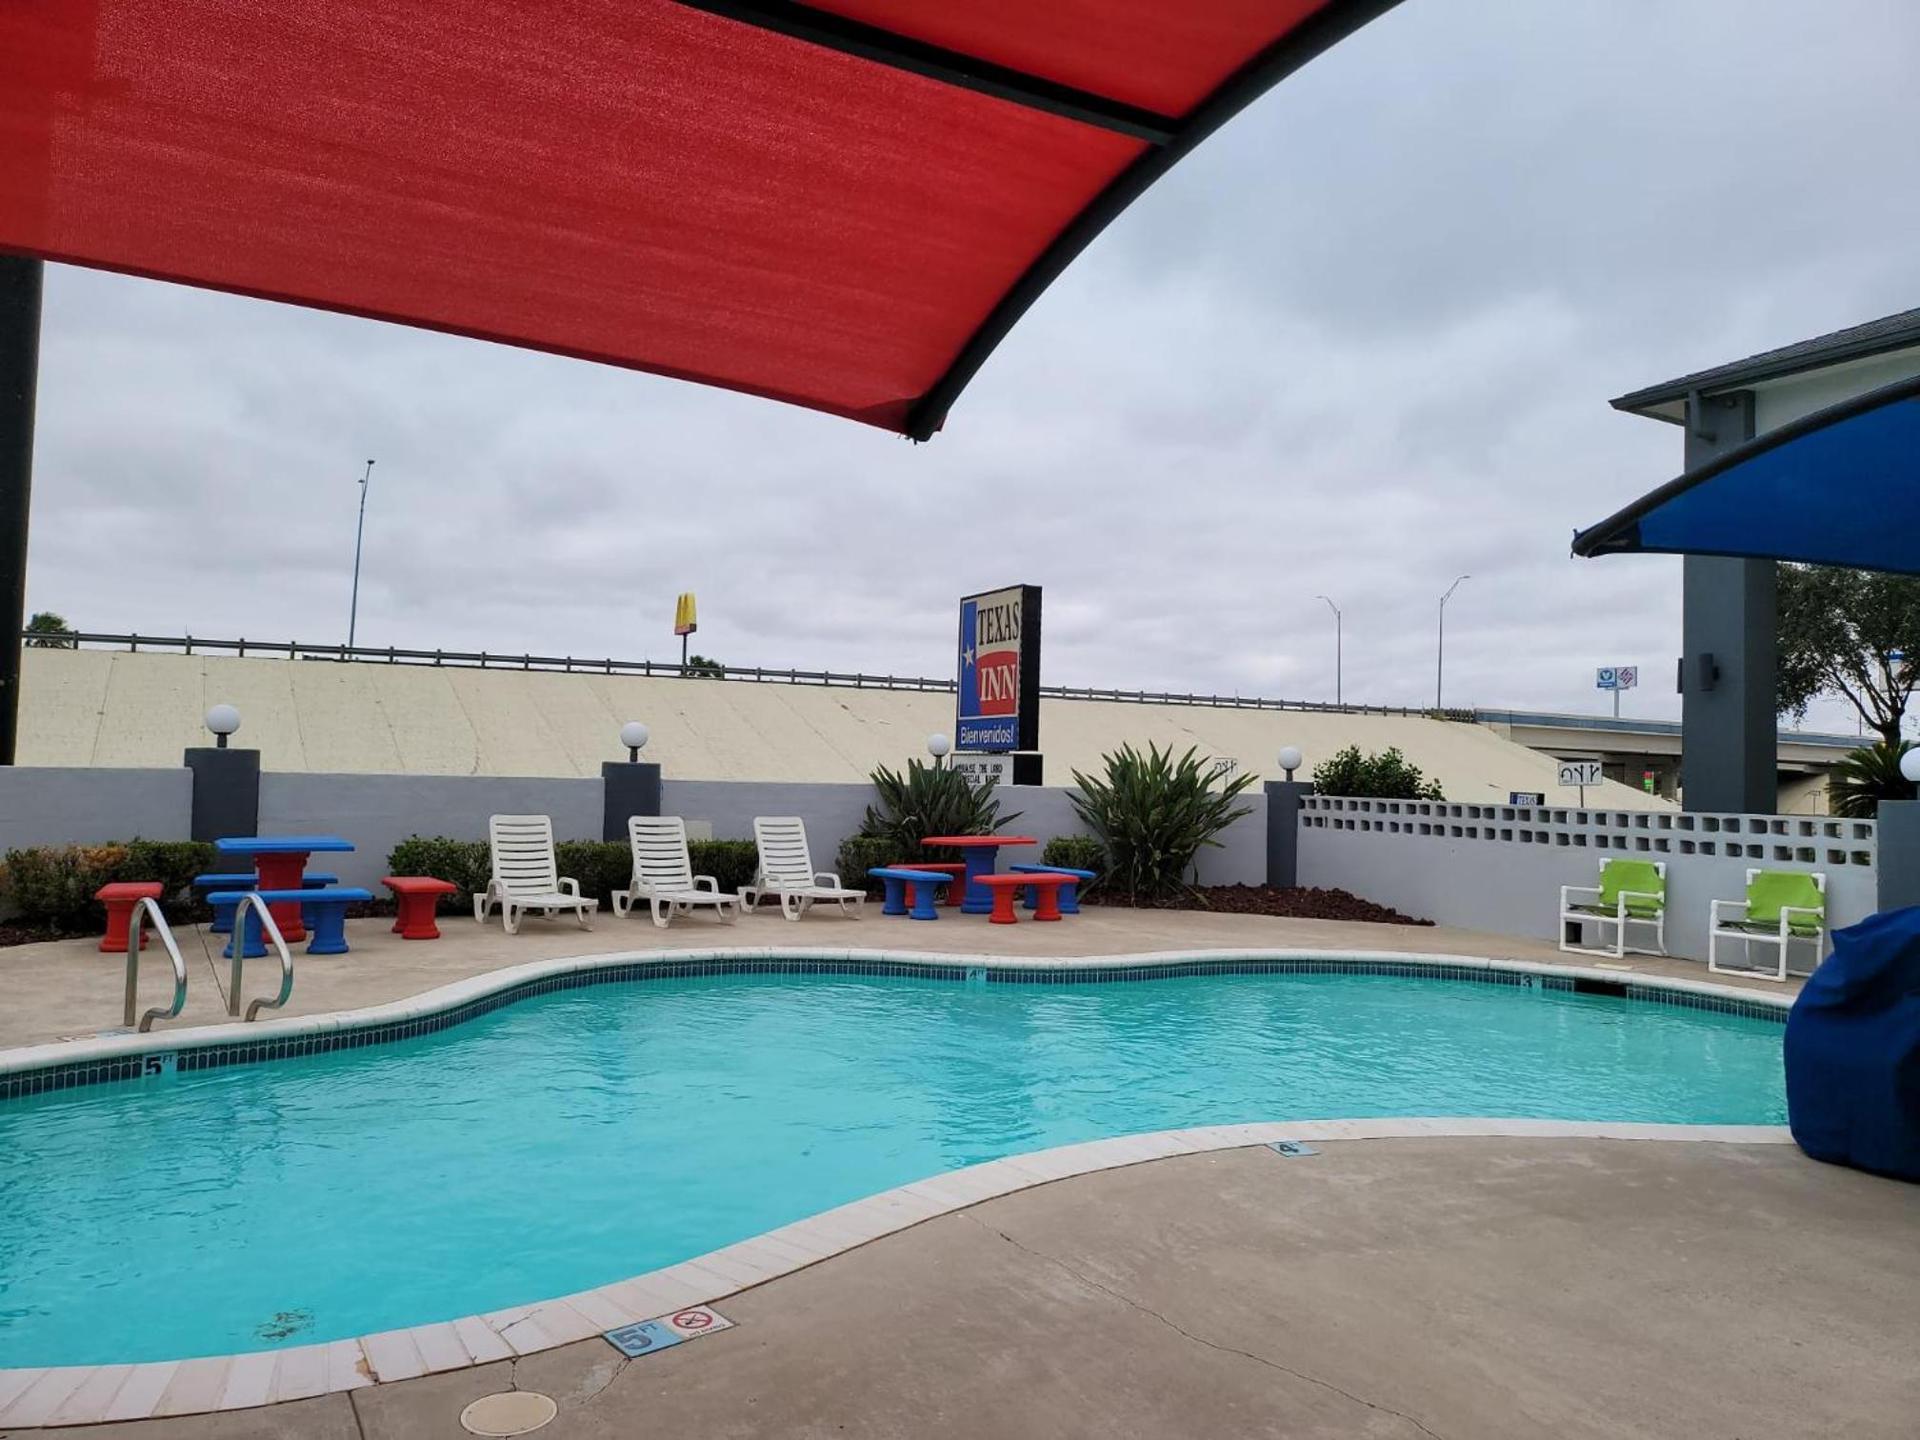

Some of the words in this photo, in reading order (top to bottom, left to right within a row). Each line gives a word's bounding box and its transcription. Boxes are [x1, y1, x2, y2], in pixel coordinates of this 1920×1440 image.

[978, 601, 1020, 645] TEXAS
[980, 664, 1016, 701] INN
[960, 724, 1015, 744] Bienvenidos!
[144, 1055, 162, 1076] 5
[612, 1328, 653, 1350] 5
[638, 1322, 658, 1333] FT
